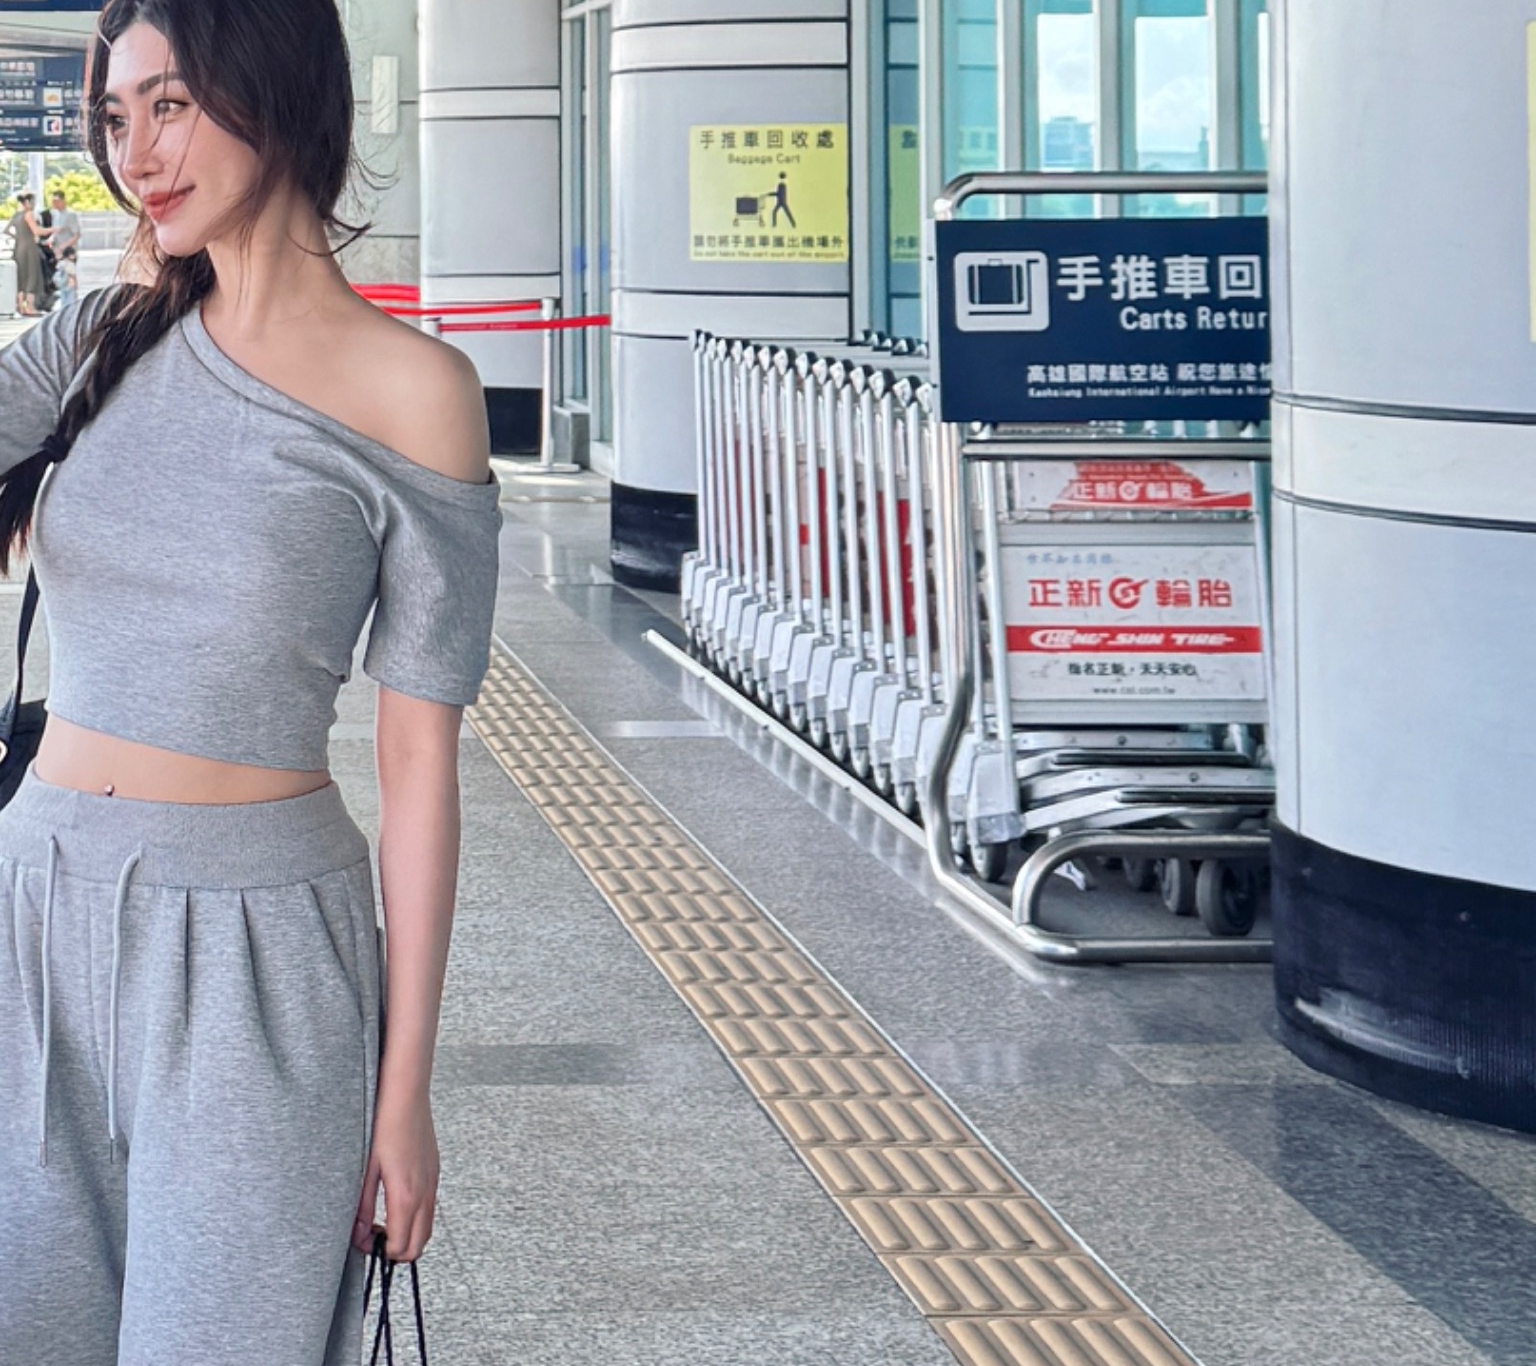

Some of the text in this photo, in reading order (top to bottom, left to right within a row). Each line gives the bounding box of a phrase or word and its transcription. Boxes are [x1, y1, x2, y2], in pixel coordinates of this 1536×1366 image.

[700, 129, 834, 149] 手推車回收處
[776, 153, 801, 164] Cart
[1056, 254, 1263, 301] 手推車回
[1119, 306, 1188, 330] Carts
[1027, 363, 1170, 383] 高雄國際航空站
[1086, 385, 1160, 397] International
[1163, 385, 1206, 398] Airport
[1028, 578, 1102, 608] 正新
[1155, 578, 1232, 608] 輪胎
[1107, 632, 1164, 646] SHIN
[1170, 633, 1236, 646] TIRE
